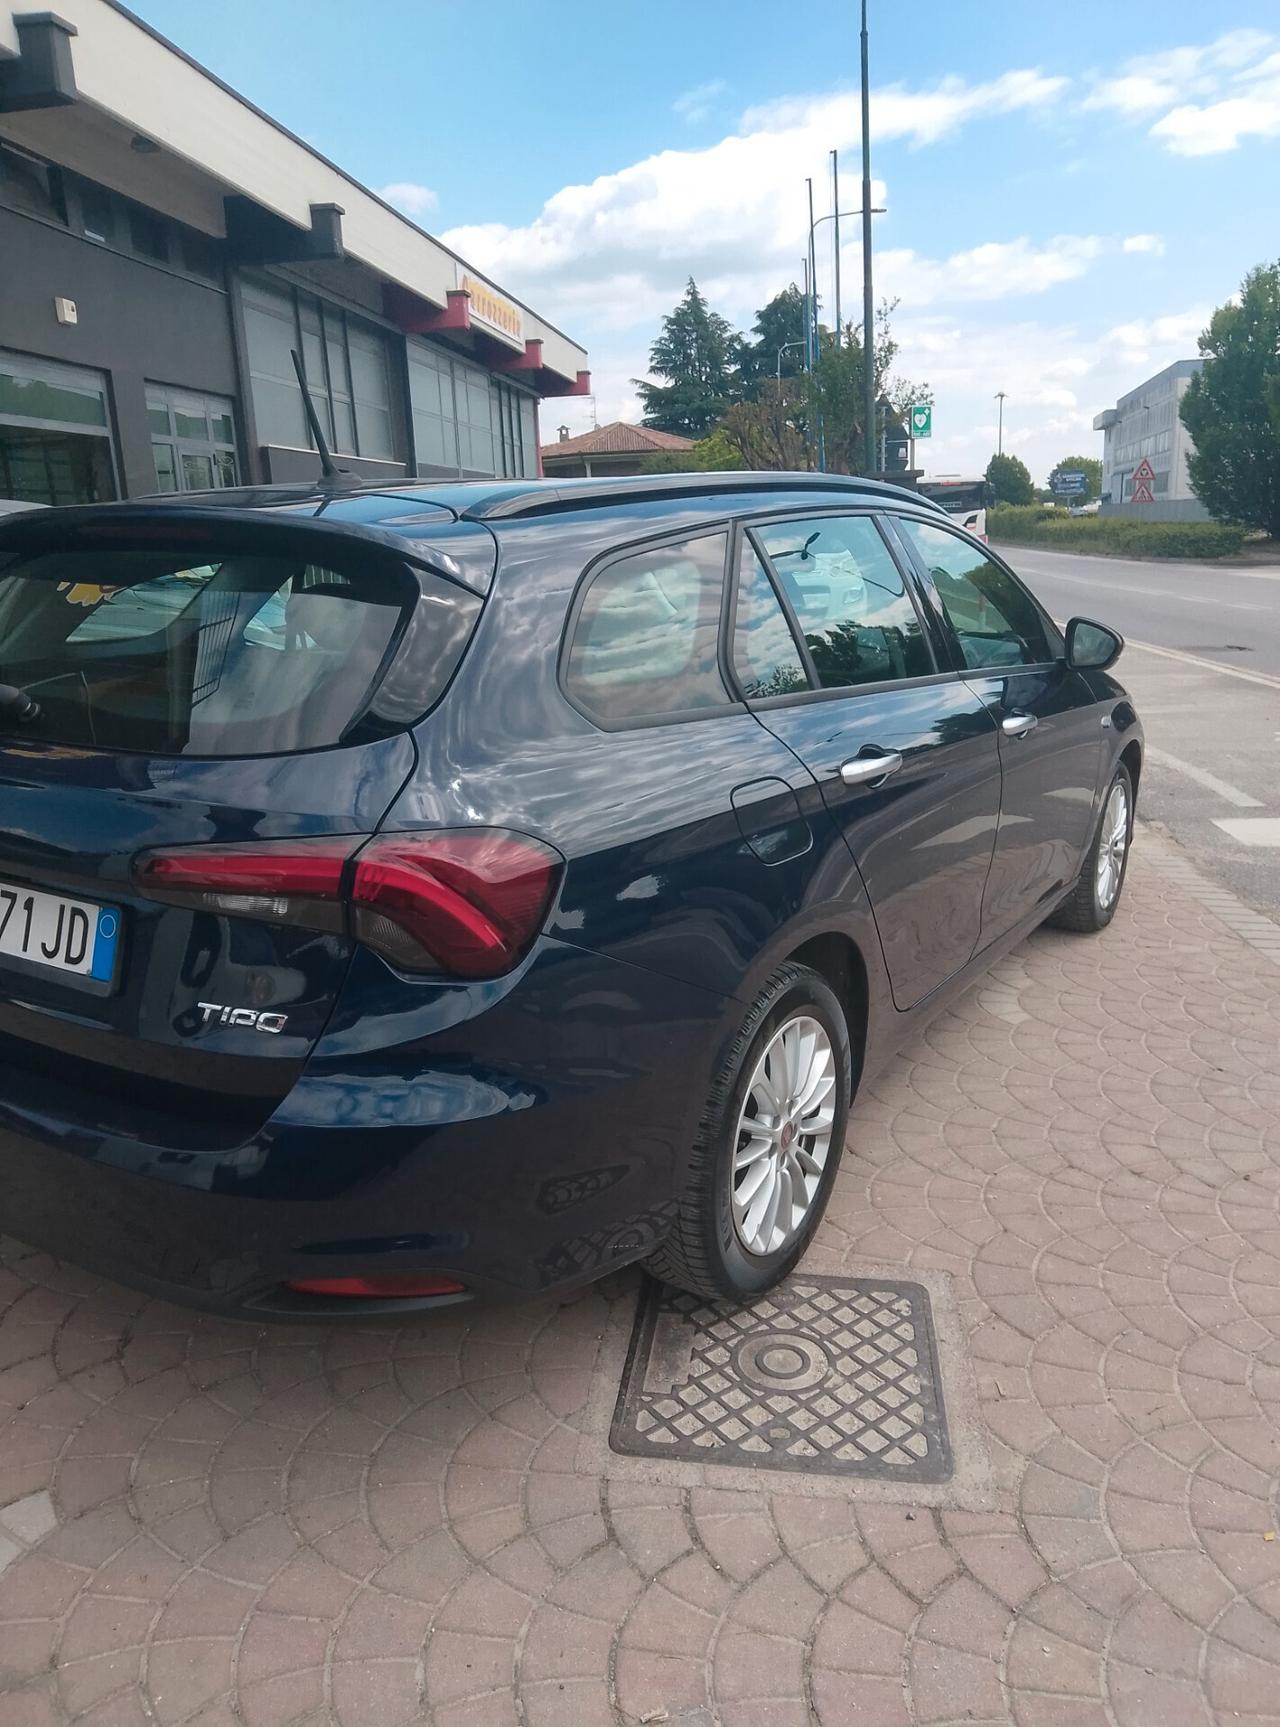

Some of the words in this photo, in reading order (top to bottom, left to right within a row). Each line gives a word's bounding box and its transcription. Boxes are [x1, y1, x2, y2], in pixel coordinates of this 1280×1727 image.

[0, 889, 34, 953] 71
[41, 904, 89, 965] JD
[197, 1001, 289, 1034] TIPO
